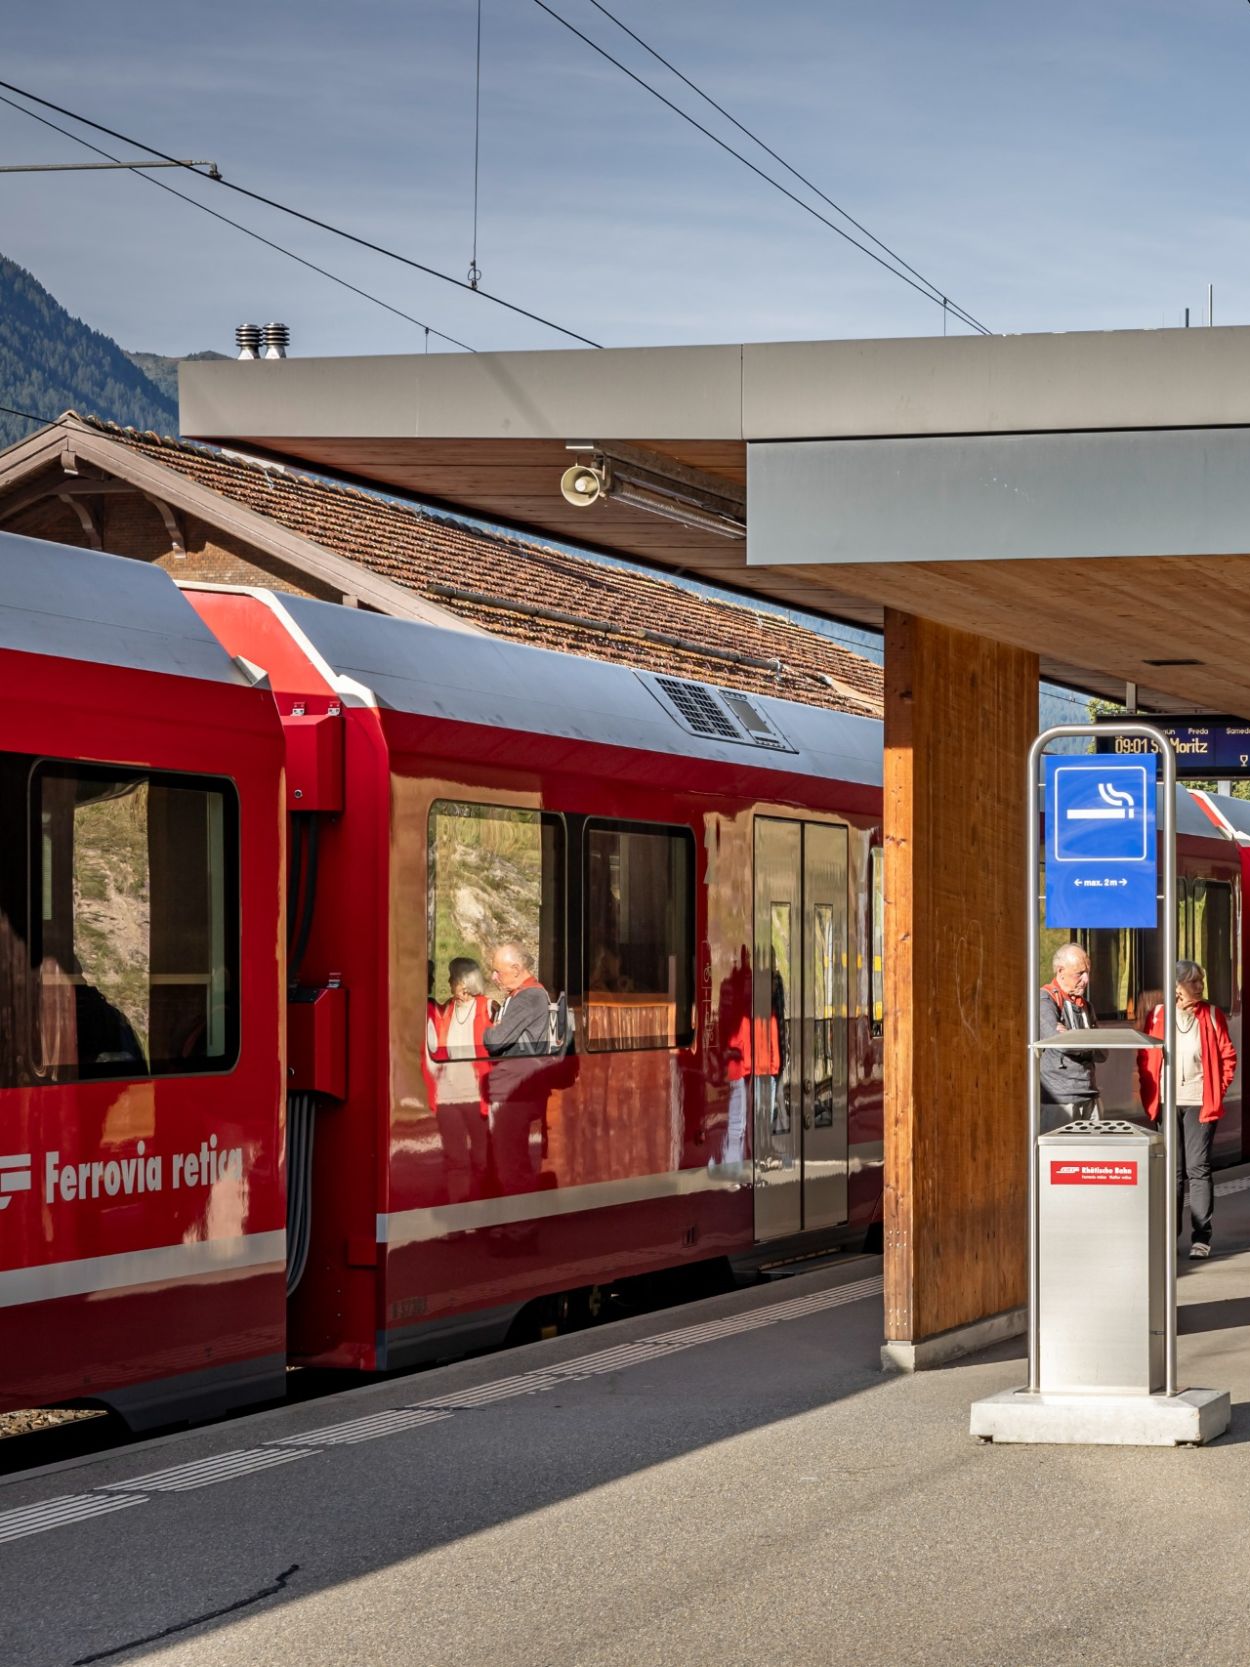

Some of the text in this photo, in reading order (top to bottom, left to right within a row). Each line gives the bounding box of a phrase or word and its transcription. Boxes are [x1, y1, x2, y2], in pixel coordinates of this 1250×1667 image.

[1188, 727, 1209, 735] Preda
[1115, 738, 1148, 754] 09:01
[1170, 737, 1208, 754] Moritz
[45, 1140, 162, 1204] Ferrovia
